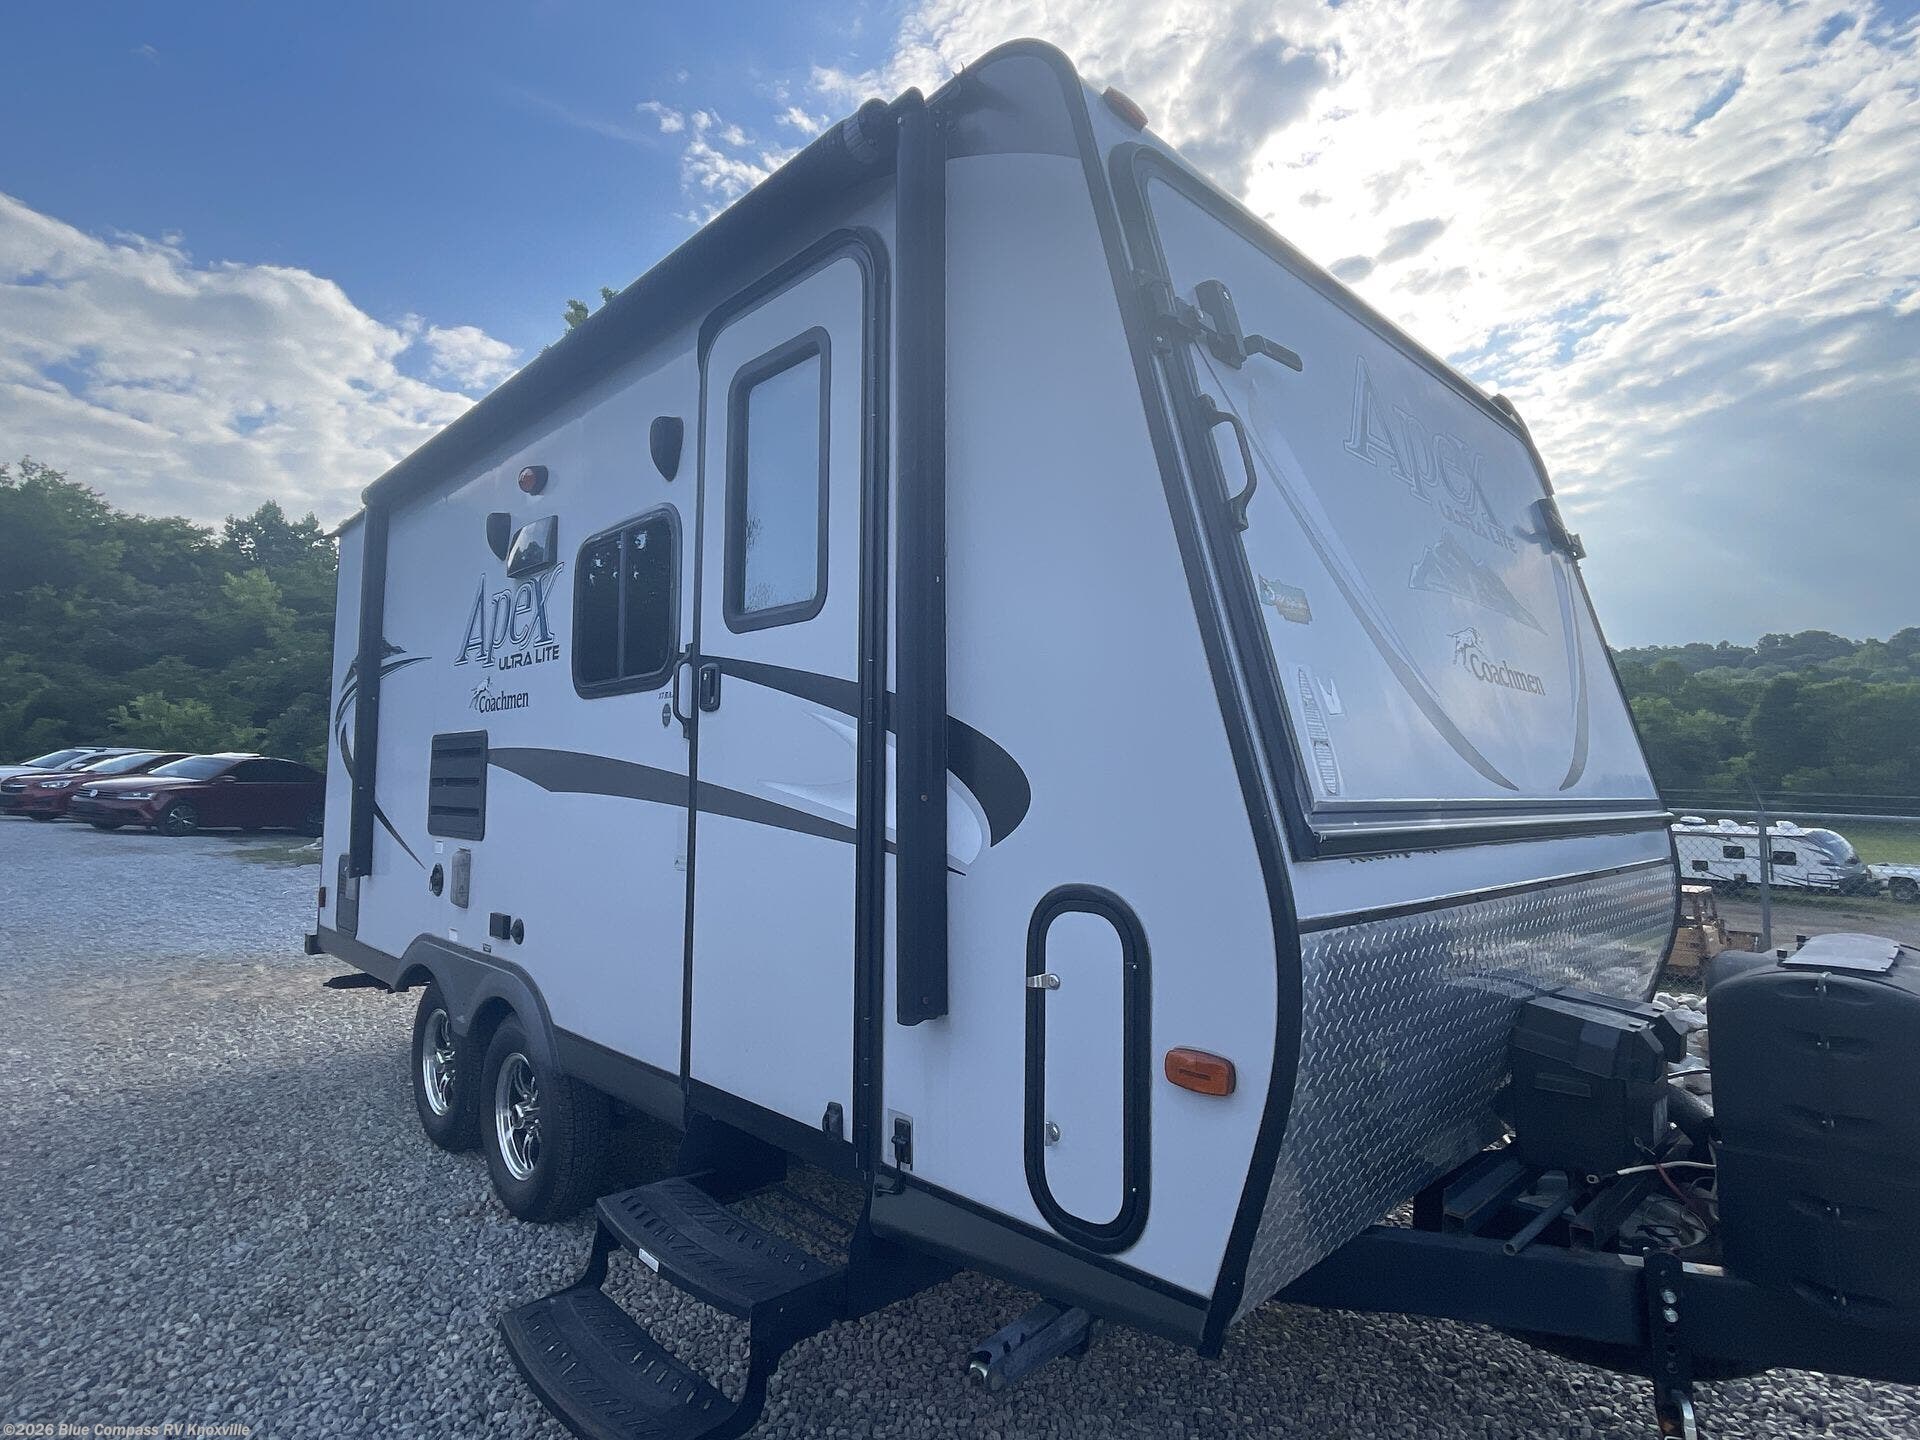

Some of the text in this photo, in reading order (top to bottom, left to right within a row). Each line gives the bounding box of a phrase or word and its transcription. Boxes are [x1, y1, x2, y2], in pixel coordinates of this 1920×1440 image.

[498, 644, 560, 670] ULTRA LITE
[1469, 653, 1546, 696] Coachmen
[479, 690, 529, 714] Coachmen
